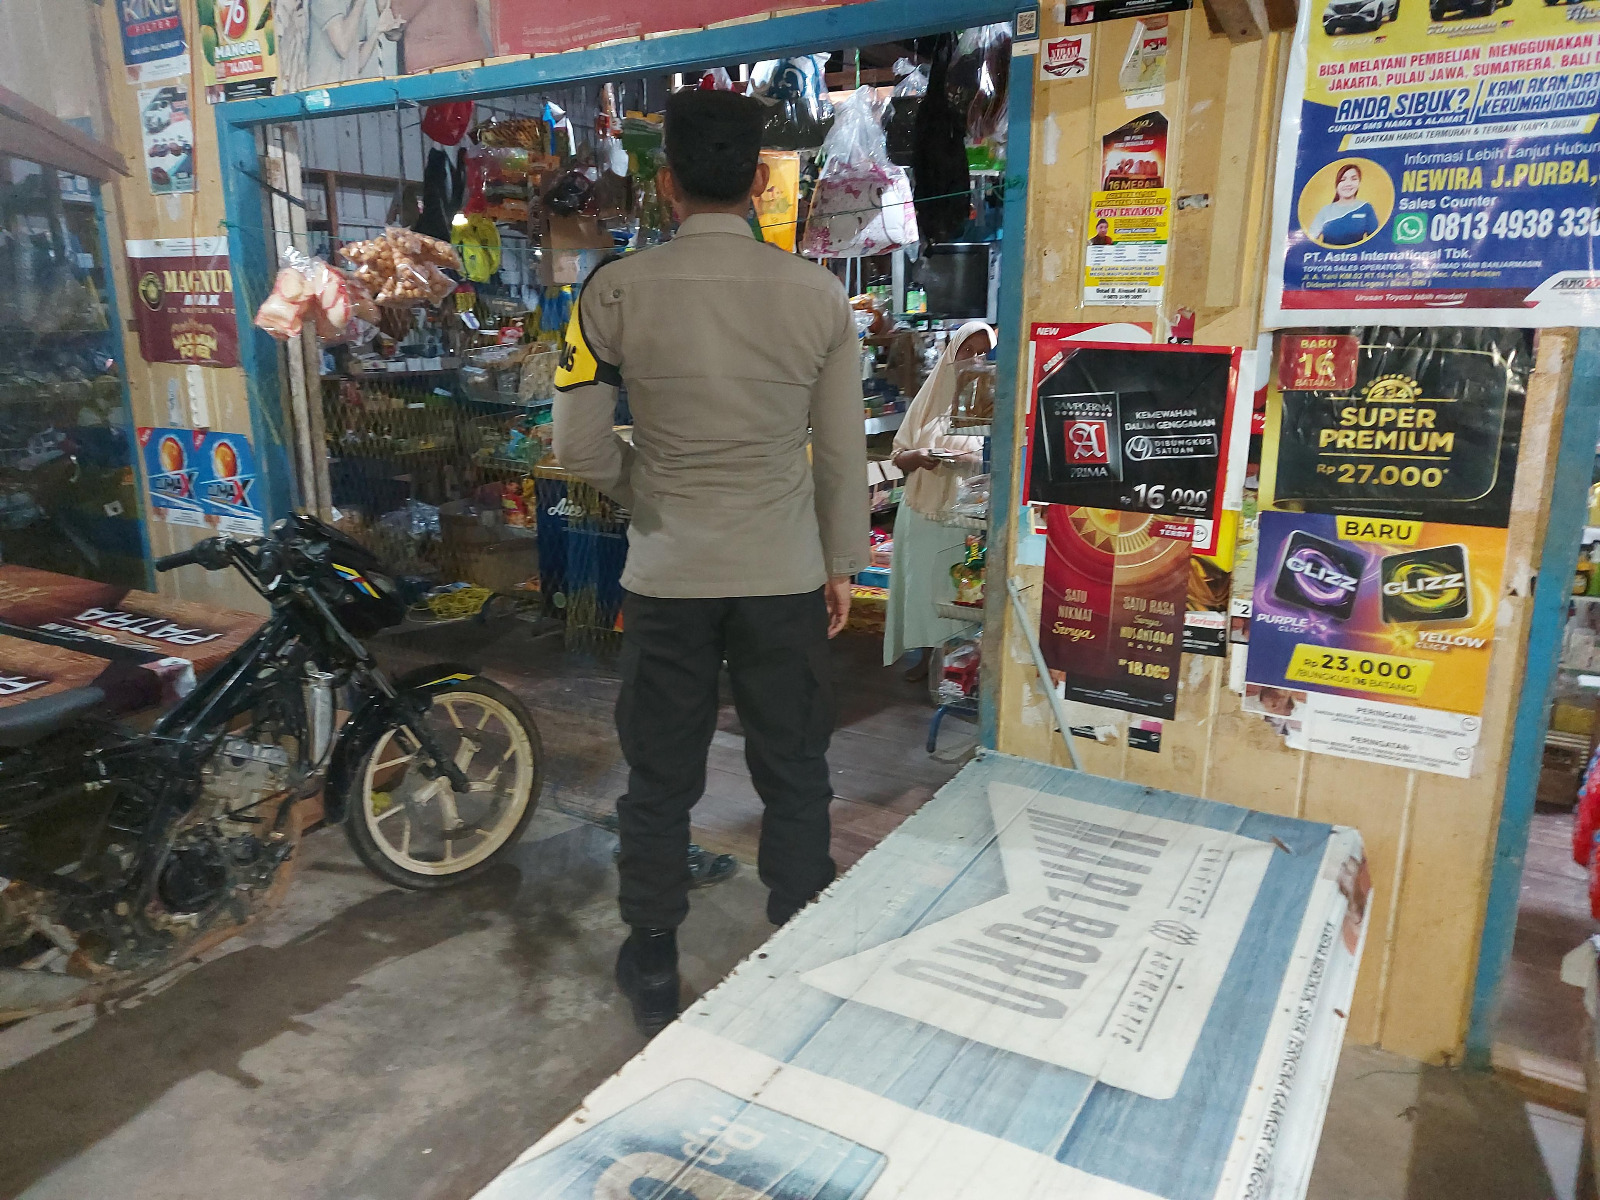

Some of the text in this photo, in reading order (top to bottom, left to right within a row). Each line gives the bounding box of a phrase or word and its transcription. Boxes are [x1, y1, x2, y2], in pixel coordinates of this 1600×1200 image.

[214, 41, 261, 59] MANGGA
[1319, 63, 1345, 77] BISA
[1349, 56, 1407, 73] MELAYANI
[1410, 48, 1481, 67] PEMBELIAN
[1488, 34, 1594, 59] MENGGUNAKAN
[1328, 75, 1382, 91] JAKARTA,
[1386, 70, 1425, 86] PULAU
[1561, 51, 1591, 67] BALI
[1487, 79, 1525, 98] KAMI
[1336, 88, 1471, 121] ANDA SIBUK?
[1481, 89, 1597, 115] KERUMAH ANDA
[1327, 123, 1361, 133] CUKUP
[1384, 119, 1413, 129] NAMA
[1425, 114, 1467, 125] ALAMAT
[1355, 133, 1395, 144] DAPATKAN
[1425, 127, 1472, 139] TERMURAH
[1482, 123, 1518, 134] TERBAIK
[1520, 121, 1549, 131] HANYA
[1404, 150, 1463, 166] Informasi
[1467, 147, 1504, 163] Lebih
[1507, 143, 1551, 162] Lanjut
[1401, 166, 1483, 193] NEWIRA
[1399, 195, 1499, 211] Sales Counter
[1430, 211, 1490, 242] 0813
[1492, 208, 1555, 240] 4938
[1304, 247, 1473, 263] PT. Astra International Tbk.
[1303, 265, 1332, 273] TOYOTA
[1036, 327, 1060, 336] NEW
[1301, 339, 1338, 350] BARU
[1299, 352, 1336, 378] 16
[1294, 378, 1337, 388] BATANG
[1135, 408, 1198, 420] KEMEWAHAN
[1340, 406, 1437, 429] SUPER
[1124, 418, 1216, 431] DALAM GENGGAMAN
[1154, 438, 1213, 447] DIBUNGKUS
[1319, 428, 1455, 453] PREMIUM
[1155, 447, 1194, 455] SATUAN
[1070, 467, 1109, 478] PRIMA
[1317, 463, 1336, 476] Rp
[547, 497, 583, 516] Aice
[1344, 520, 1413, 541] BARU
[1286, 556, 1359, 593] GLIZZ
[1383, 572, 1465, 597] GLIZZ
[1064, 588, 1088, 604] SATU
[1122, 596, 1176, 616] SATU RASA
[1057, 605, 1094, 622] NIKMAT
[1256, 612, 1310, 628] PURPLE
[73, 606, 223, 646] PATRA
[1052, 621, 1096, 642] Surya
[1119, 626, 1175, 646] NUSANTARA
[1417, 630, 1486, 650] YELLOW
[893, 807, 1170, 1020] MARLBORO
[1110, 948, 1176, 1046] AUTHENTIC
